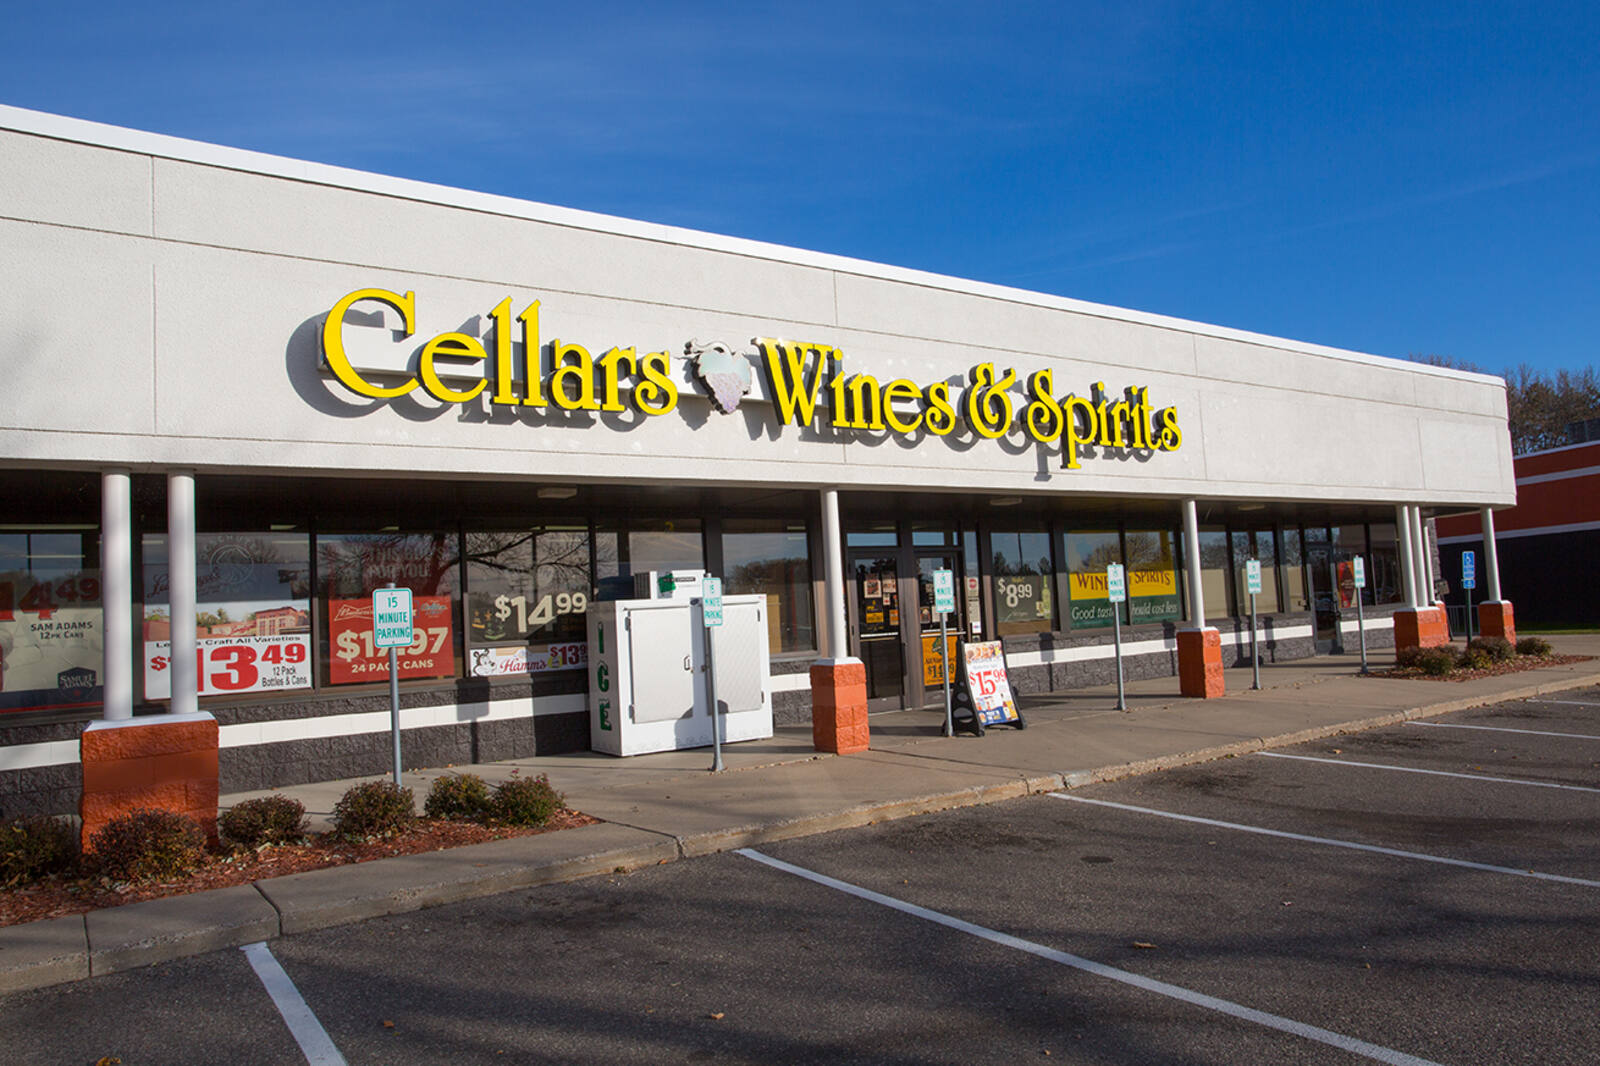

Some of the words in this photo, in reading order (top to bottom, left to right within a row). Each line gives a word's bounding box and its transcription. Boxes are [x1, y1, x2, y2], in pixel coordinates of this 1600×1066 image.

[322, 287, 679, 416] Cellars
[752, 336, 957, 435] Wines
[965, 361, 1017, 439] &
[1027, 367, 1182, 469] Spirits
[1076, 572, 1109, 592] WINE
[387, 596, 398, 609] 15
[378, 611, 409, 624] MINUTE
[1071, 605, 1096, 620] Good
[30, 622, 53, 632] SAM
[56, 621, 93, 631] ADAMS
[376, 626, 410, 640] PARKING
[205, 638, 233, 646] Craft
[235, 637, 251, 645] All
[254, 635, 301, 643] Varieties
[336, 626, 449, 663] $1.97
[272, 667, 280, 676] 12
[281, 665, 297, 676] Pack
[351, 663, 366, 674] 24
[403, 659, 434, 669] CANS
[261, 676, 284, 688] Bottles
[292, 675, 308, 686] Cans
